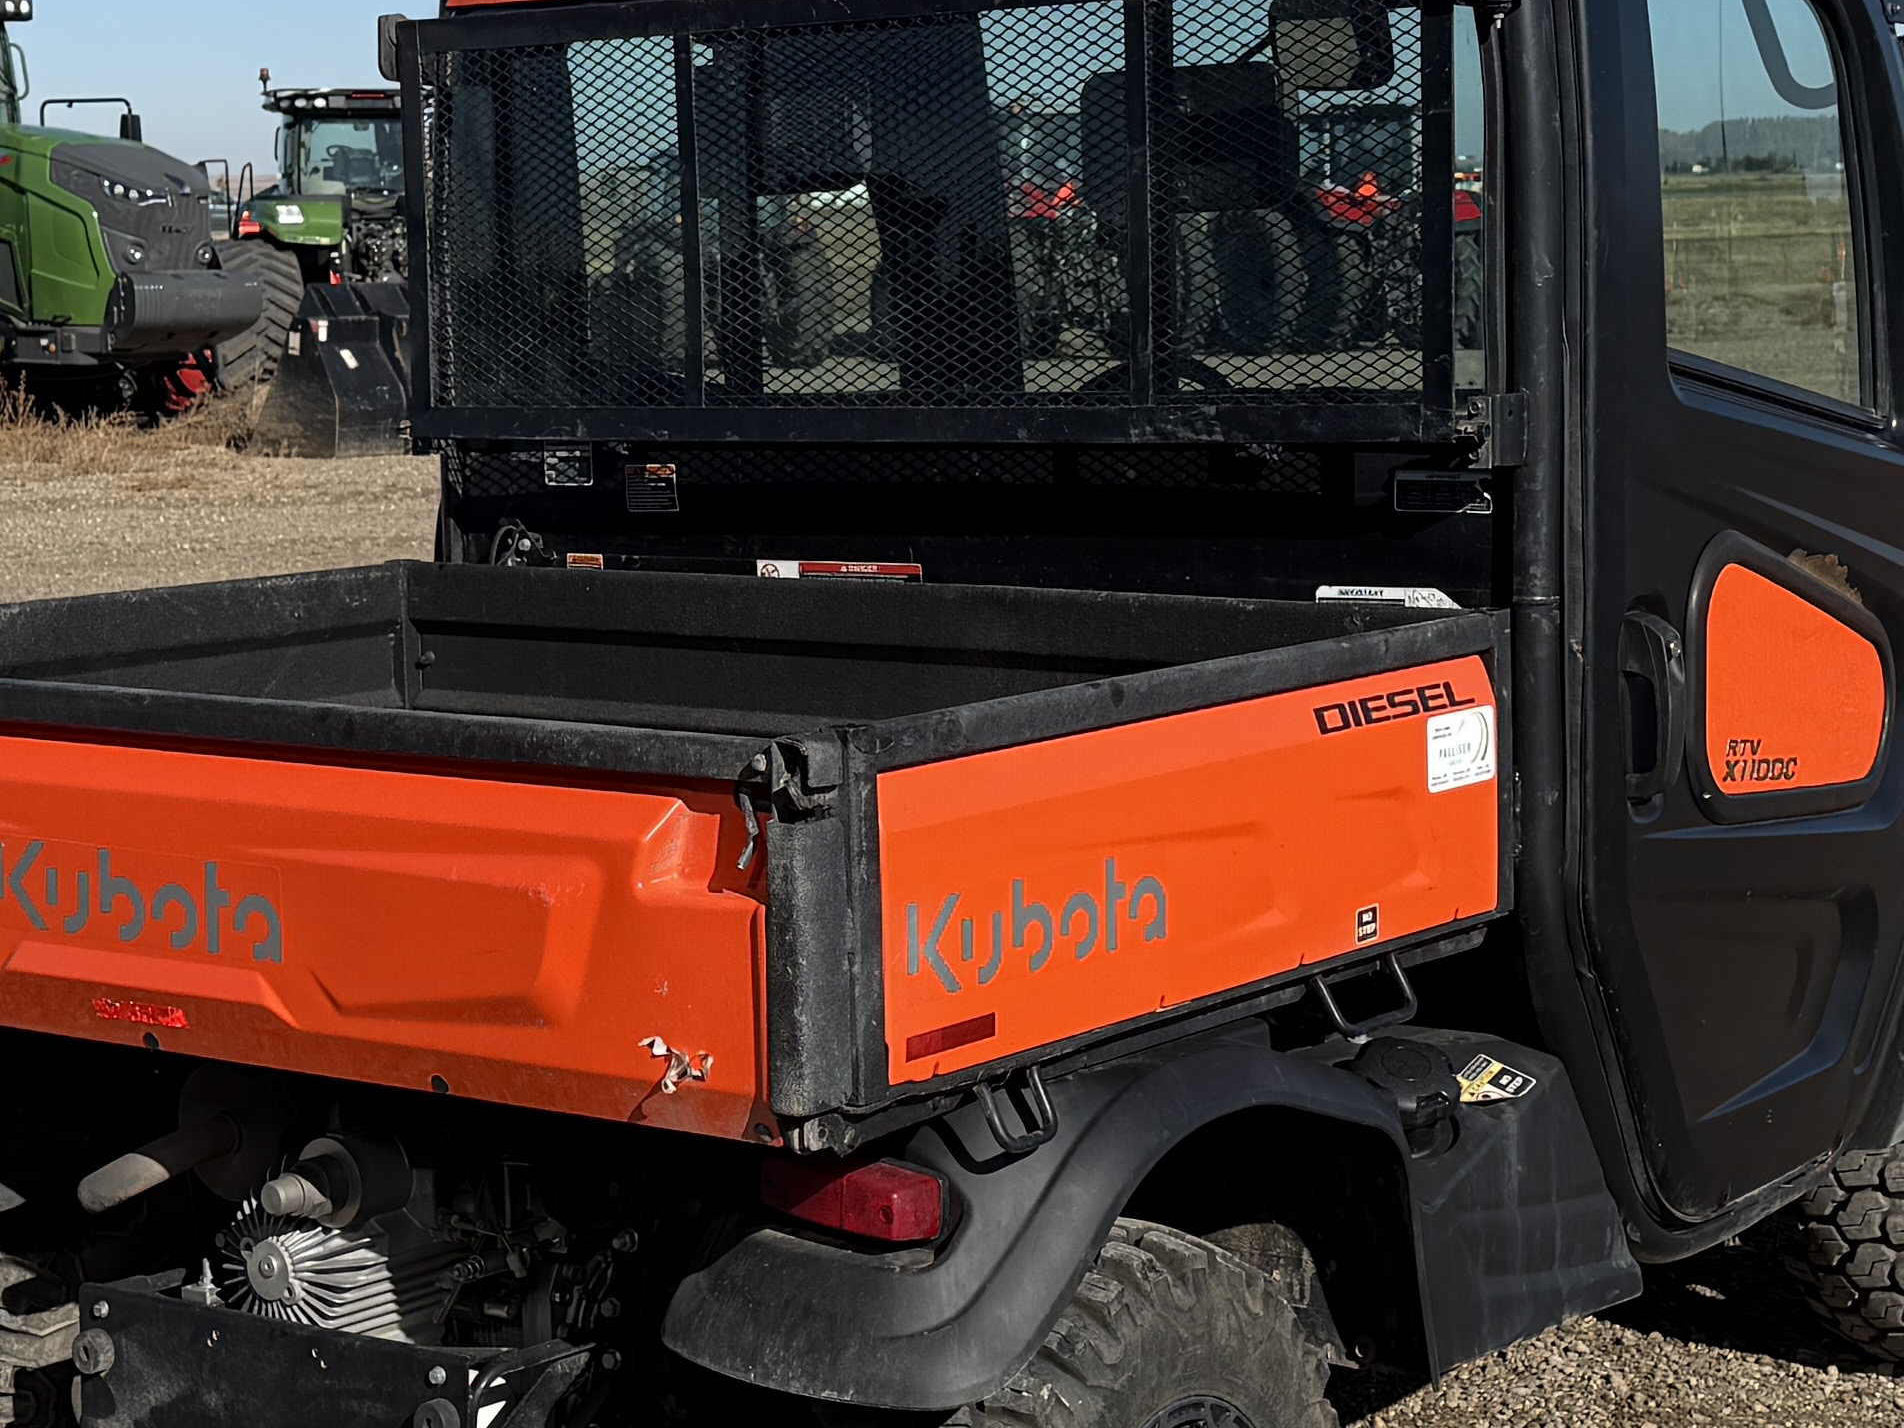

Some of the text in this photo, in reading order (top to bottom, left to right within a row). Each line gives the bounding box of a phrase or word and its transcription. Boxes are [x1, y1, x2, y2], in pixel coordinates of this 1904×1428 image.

[1313, 680, 1476, 736] DIESEL
[1725, 738, 1762, 758] RTV
[1722, 756, 1798, 783] X1100C
[906, 856, 1167, 994] Kubota
[1362, 911, 1373, 923] NO
[1358, 922, 1376, 937] STEP
